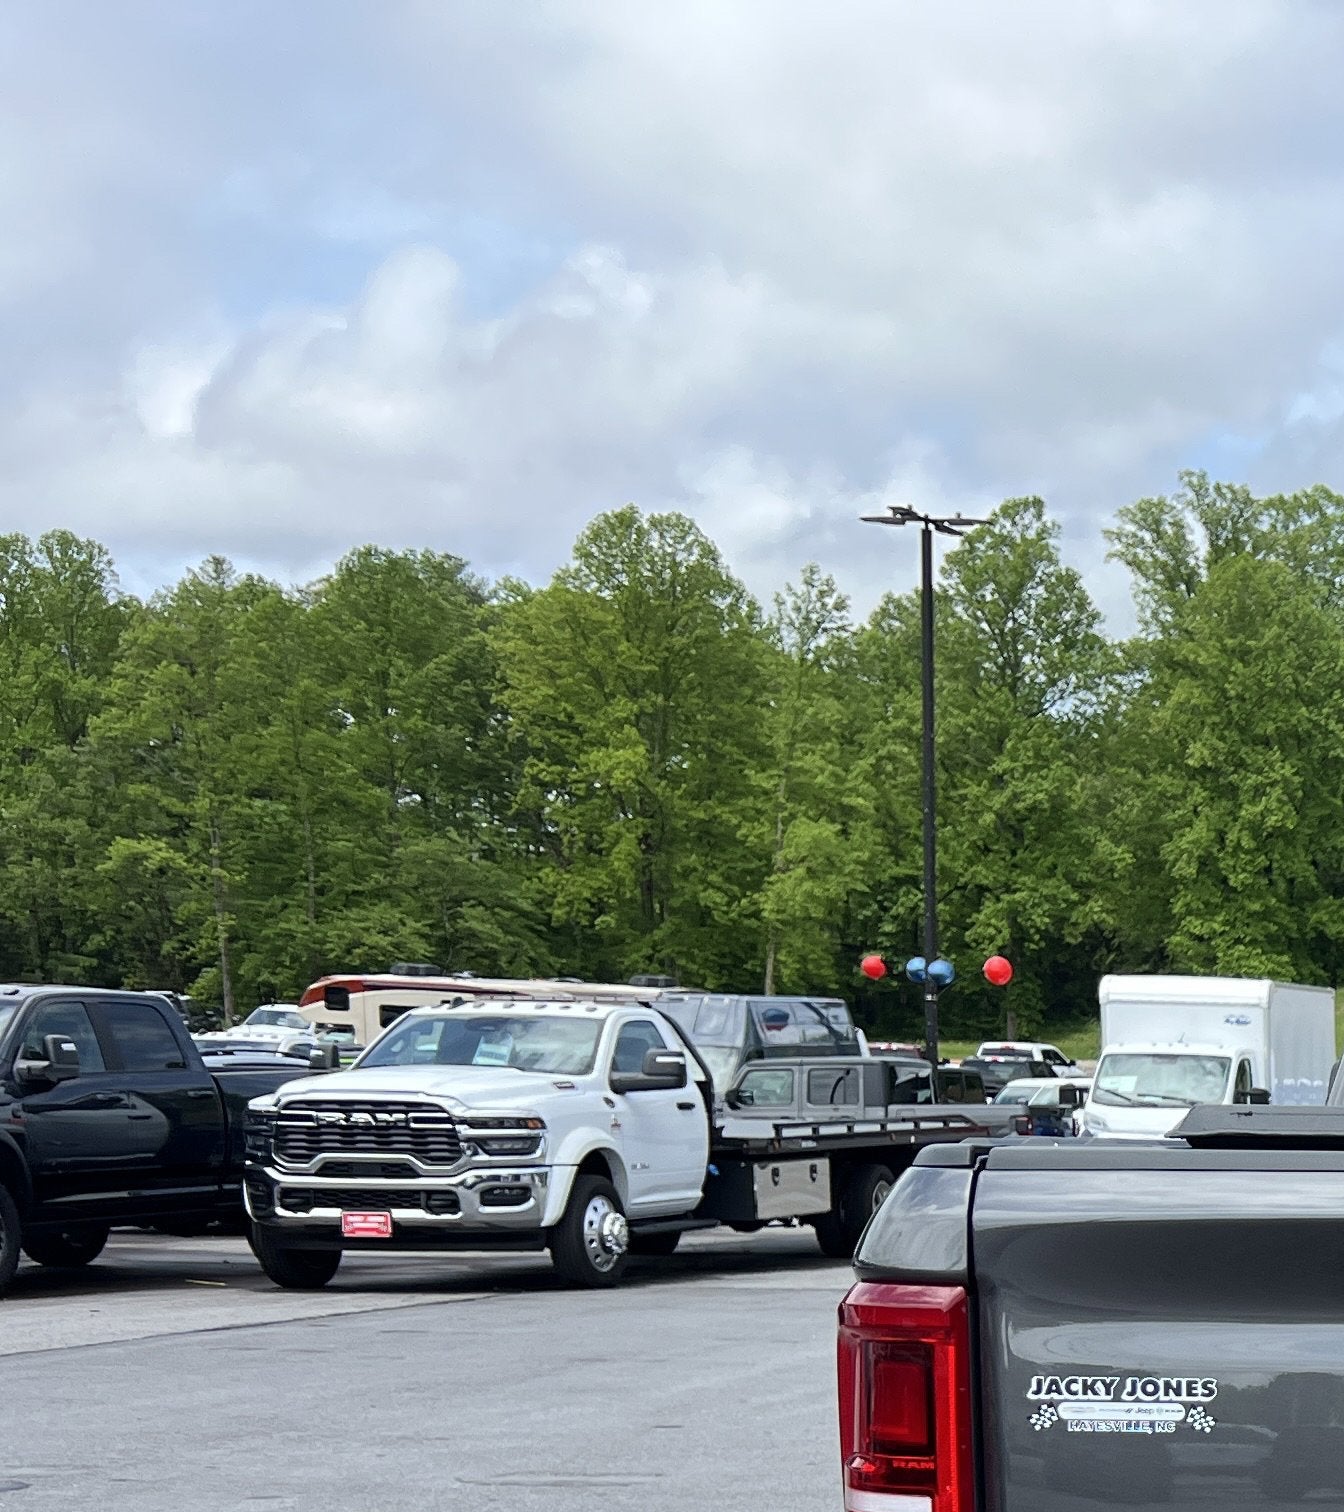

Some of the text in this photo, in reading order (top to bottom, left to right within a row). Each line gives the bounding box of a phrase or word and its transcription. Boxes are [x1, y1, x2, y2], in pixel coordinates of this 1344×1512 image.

[317, 1111, 407, 1126] RAM
[1028, 1376, 1217, 1400] JACKY JONES
